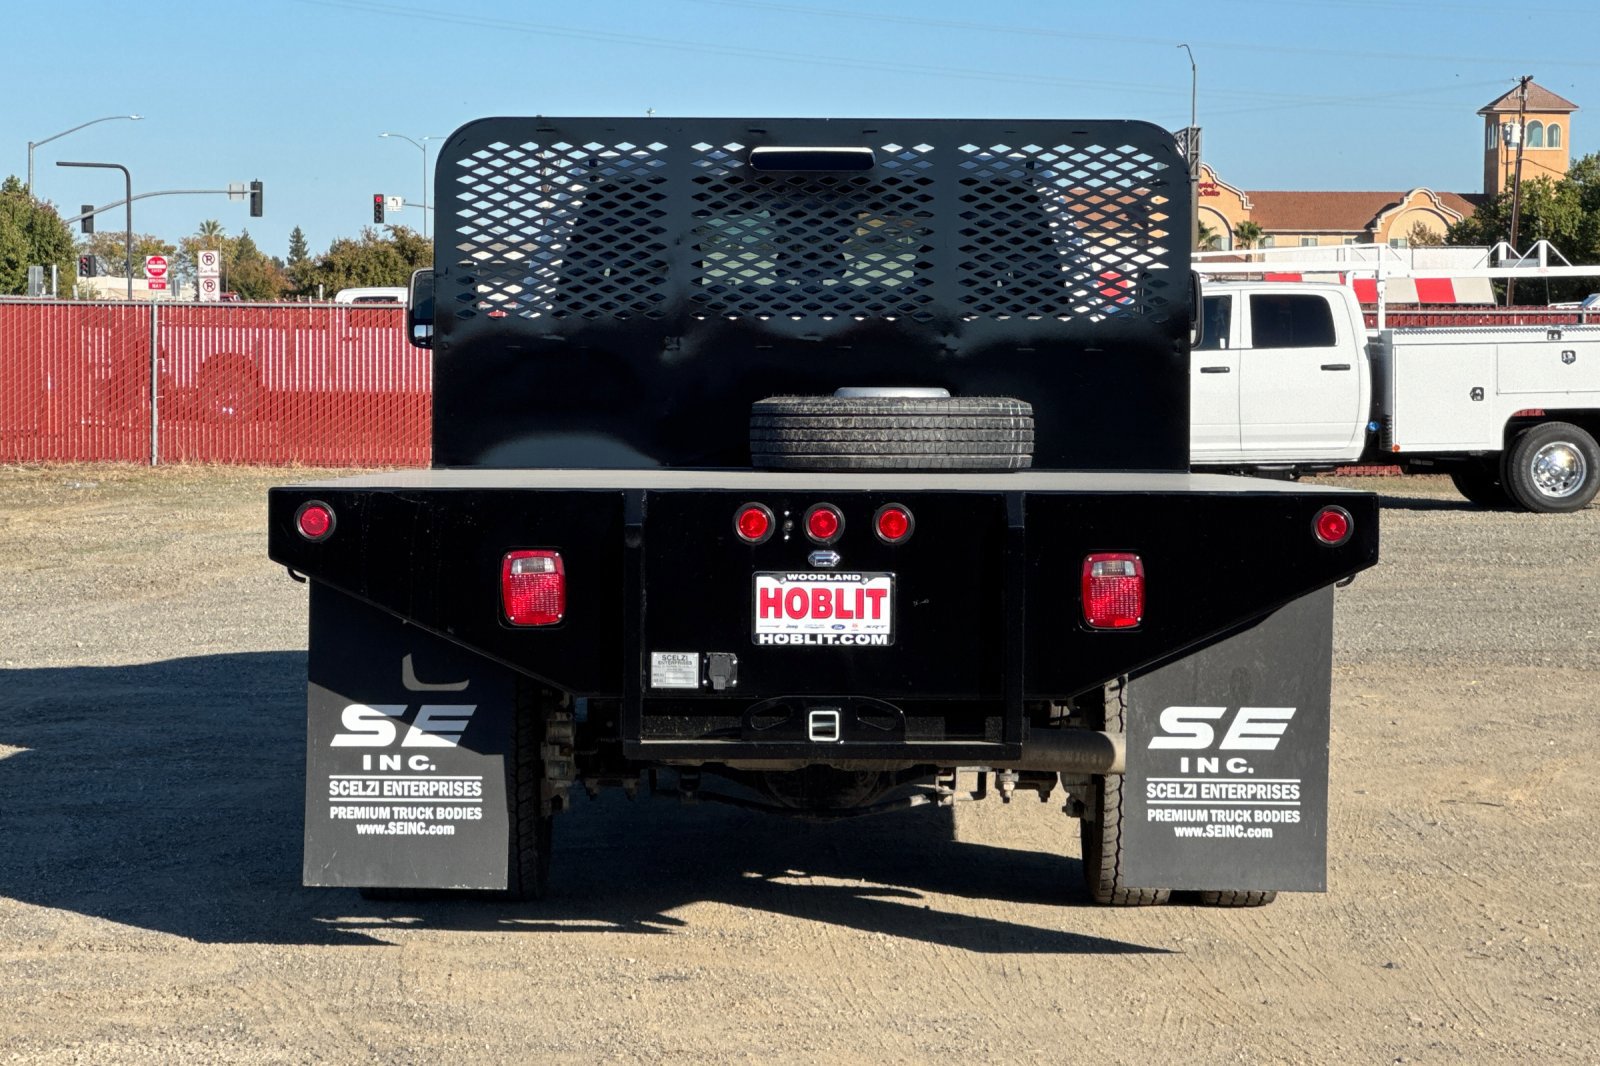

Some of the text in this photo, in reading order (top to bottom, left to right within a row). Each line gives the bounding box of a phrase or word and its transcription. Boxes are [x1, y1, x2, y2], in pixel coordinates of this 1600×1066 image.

[787, 573, 862, 582] WOODLAND
[759, 587, 888, 620] HOBLIT
[759, 634, 888, 645] HOBLIT.COM
[330, 704, 478, 747] SE
[1147, 706, 1297, 750] SE
[362, 754, 437, 771] INC.
[1180, 757, 1255, 774] INC.
[329, 780, 482, 797] SCELZI ENTERPRISES
[1146, 783, 1301, 800] SCELZI ENTERPRISES
[329, 806, 483, 820] PREMIUM TRUCK BODIES
[1147, 808, 1301, 824] PREMIUM TRUCK BODIES
[356, 821, 455, 836] www.SEINC.com
[1174, 824, 1273, 839] www.SEINC.com
